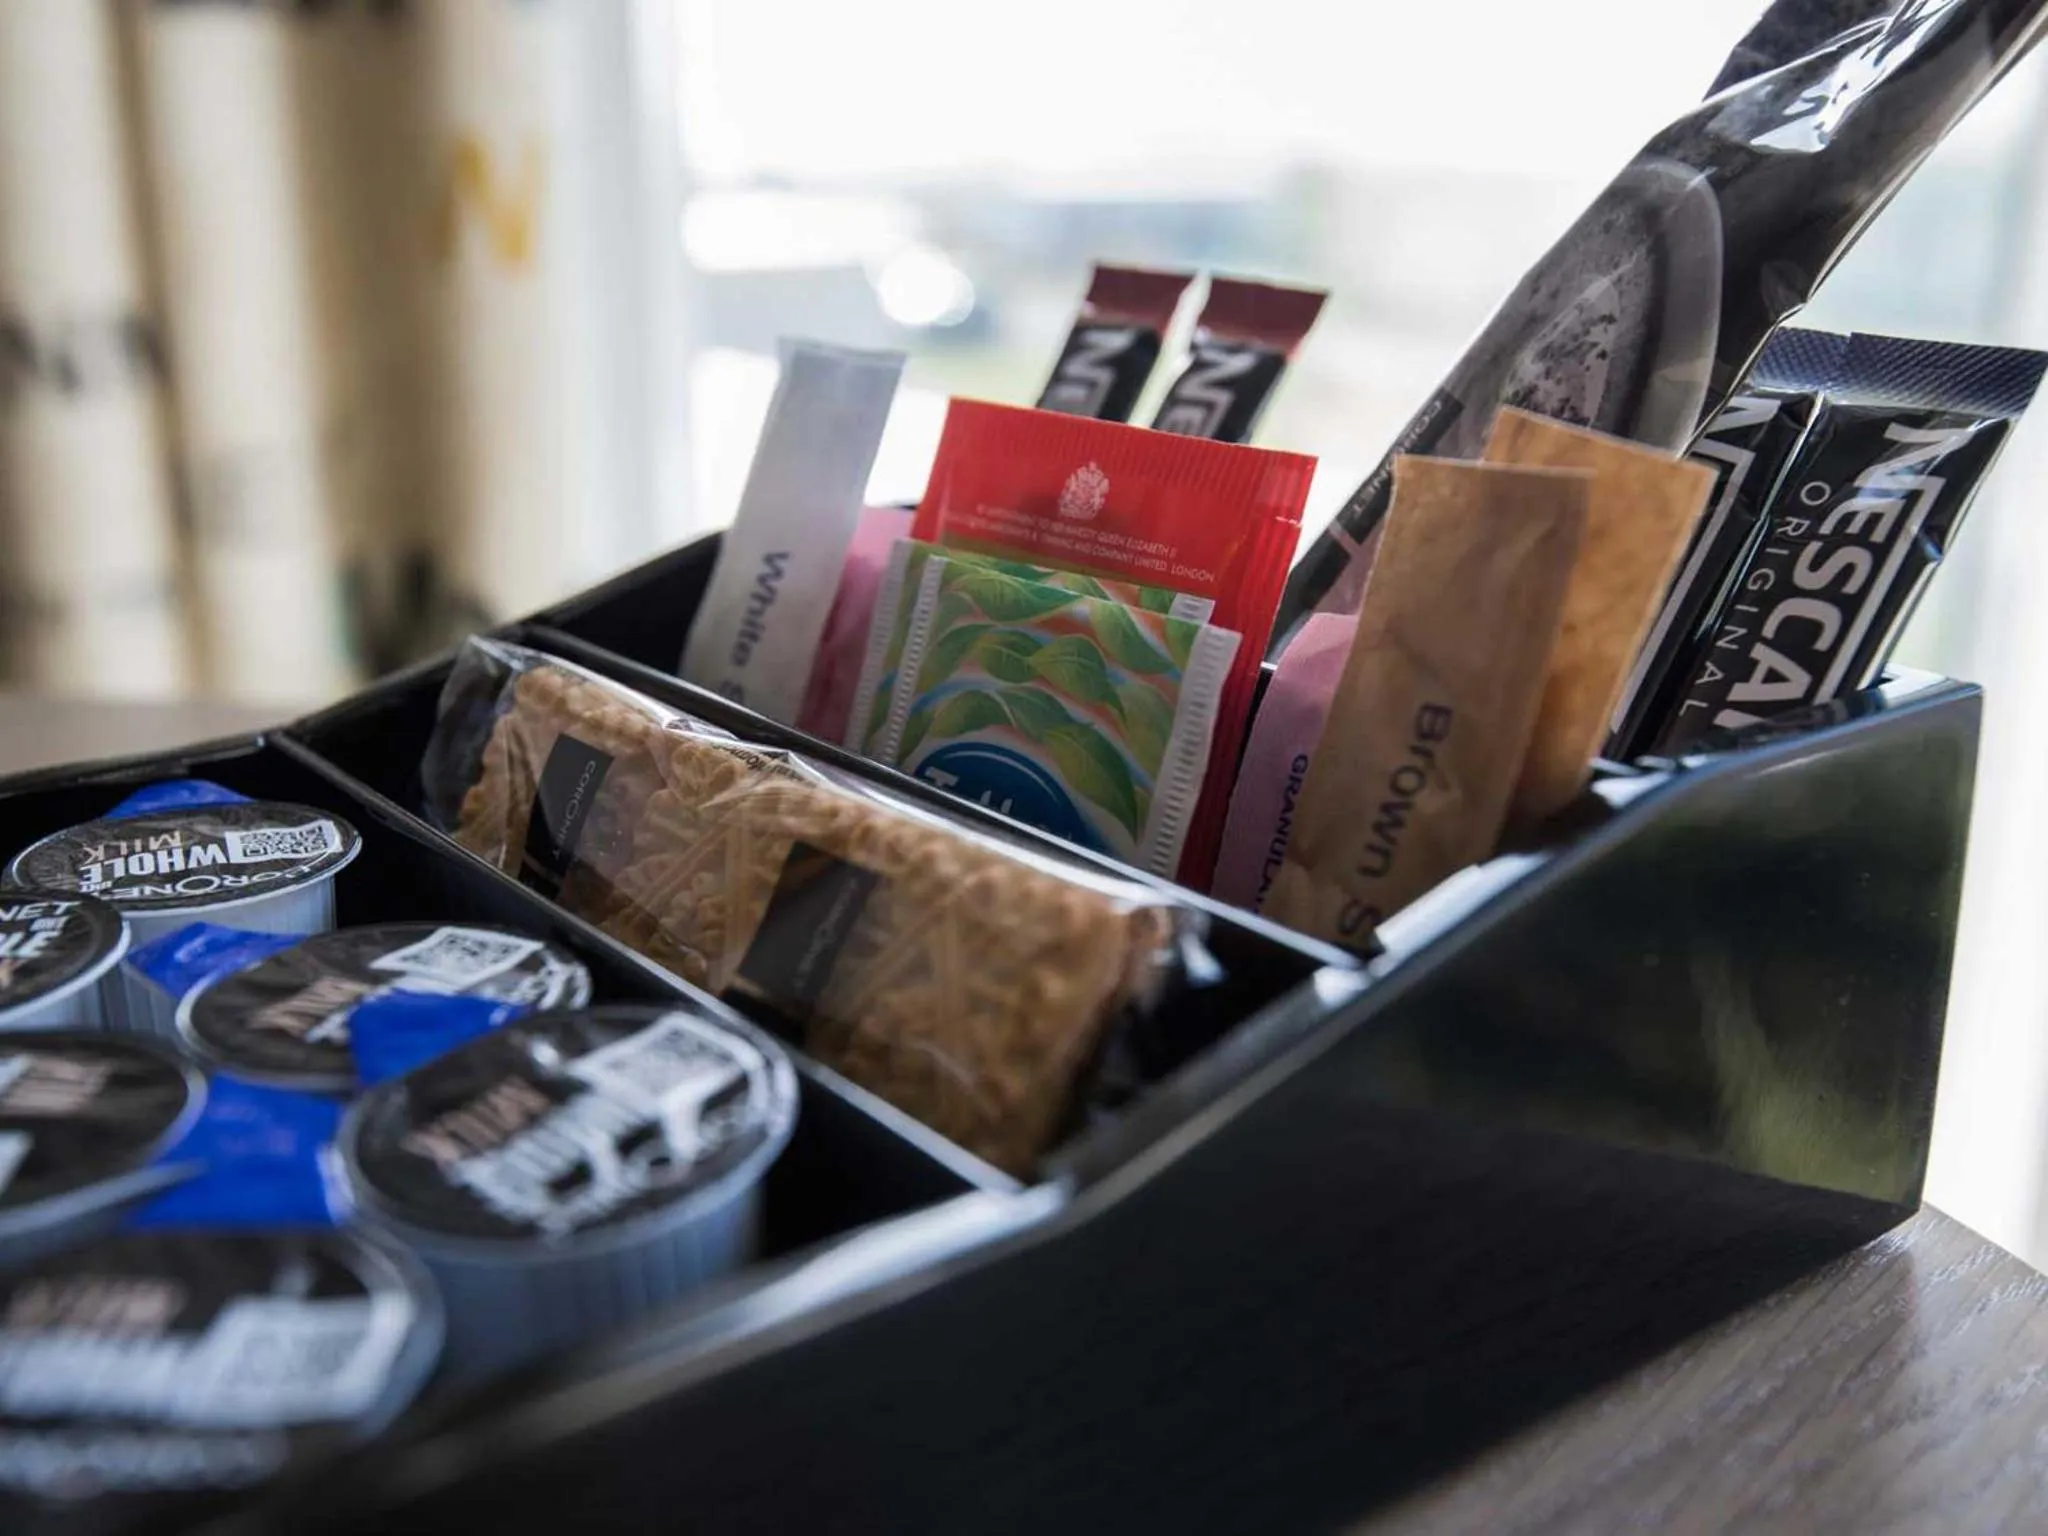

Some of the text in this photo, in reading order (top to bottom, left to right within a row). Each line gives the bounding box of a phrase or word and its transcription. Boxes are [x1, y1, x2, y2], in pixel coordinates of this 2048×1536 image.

[729, 551, 791, 669] White
[1170, 563, 1216, 583] LONDON
[1678, 480, 1832, 718] ORIGINAL
[1354, 703, 1454, 879] Brown
[79, 843, 231, 883] WHOLE
[82, 829, 182, 865] MILK
